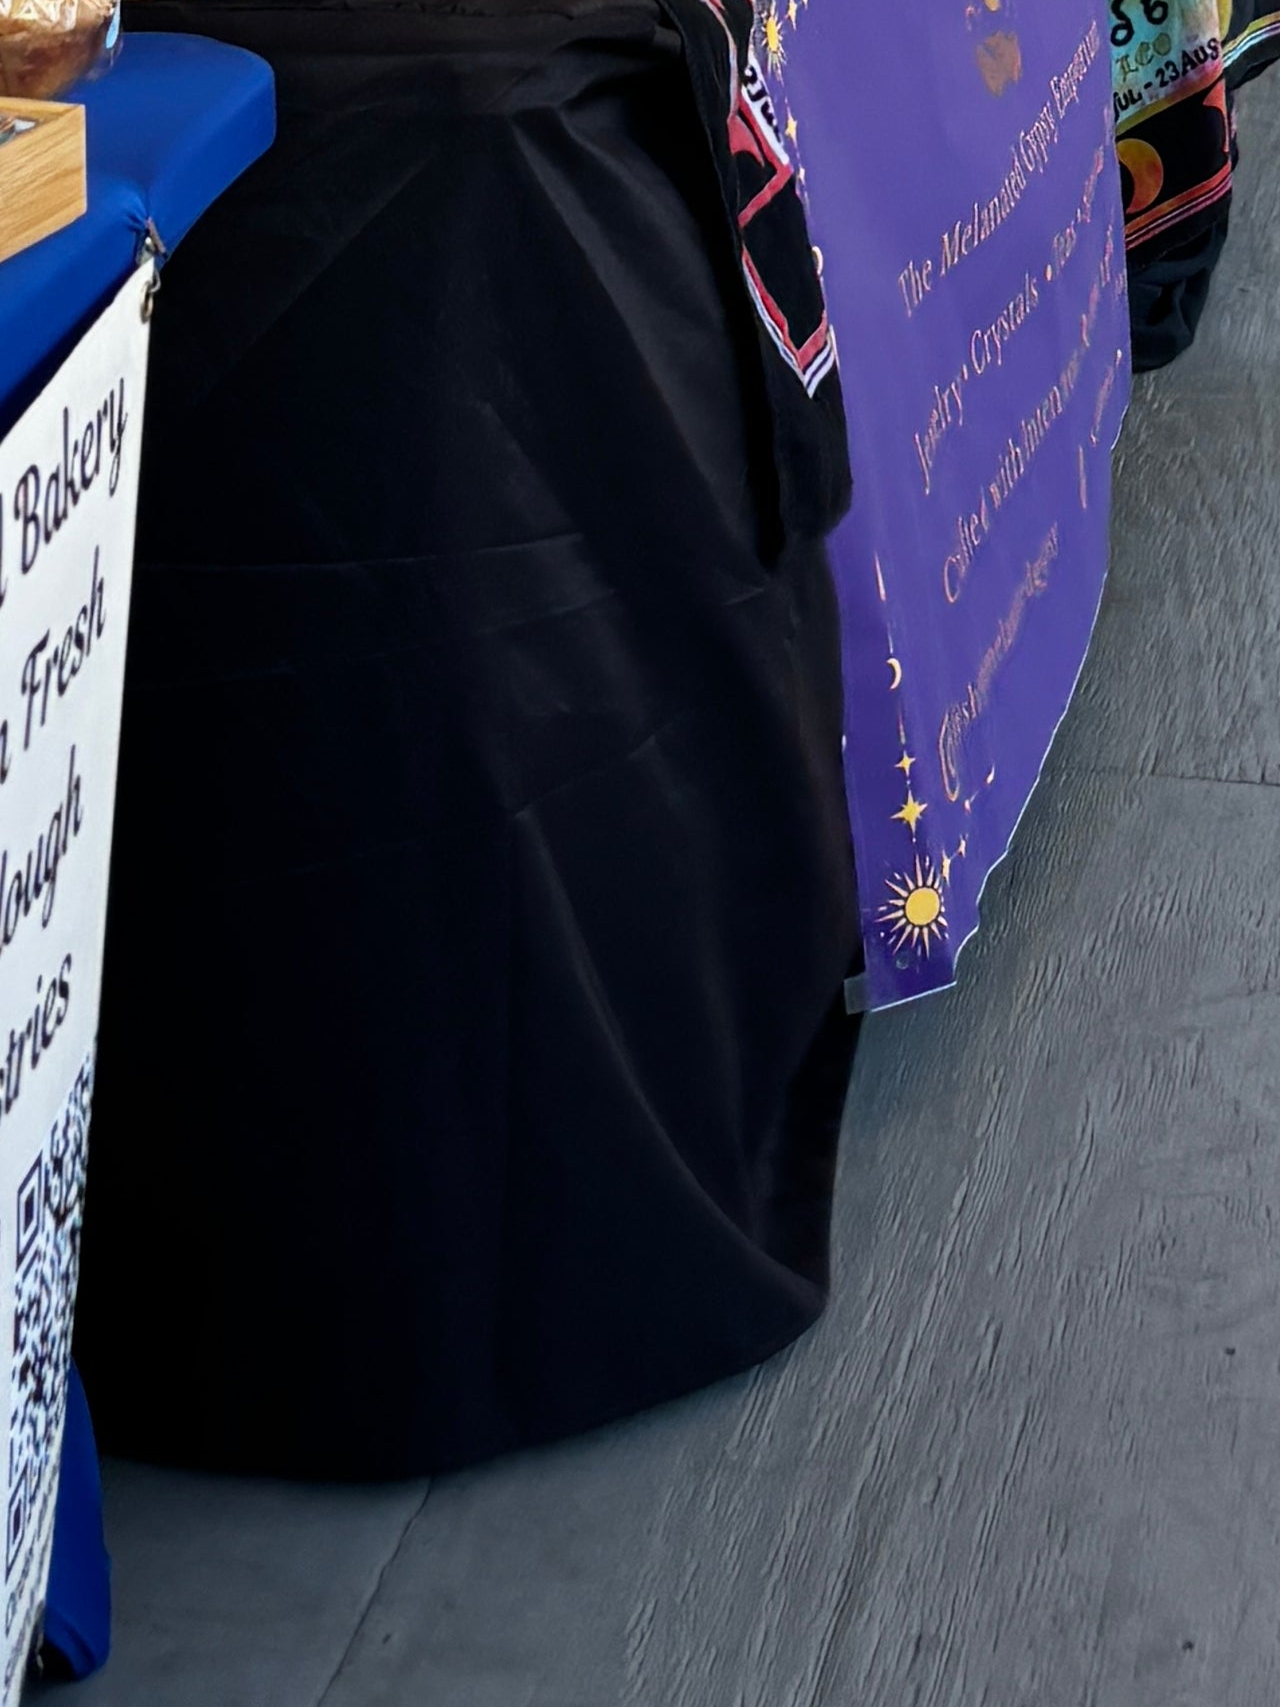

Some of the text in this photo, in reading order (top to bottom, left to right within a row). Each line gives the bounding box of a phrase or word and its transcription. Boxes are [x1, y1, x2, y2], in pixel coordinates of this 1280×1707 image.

[1155, 60, 1180, 88] 23
[897, 259, 933, 319] The
[940, 145, 1027, 278] Melanated
[970, 272, 1039, 375] Crystals
[13, 376, 128, 577] Bakery
[20, 544, 107, 751] Fresh
